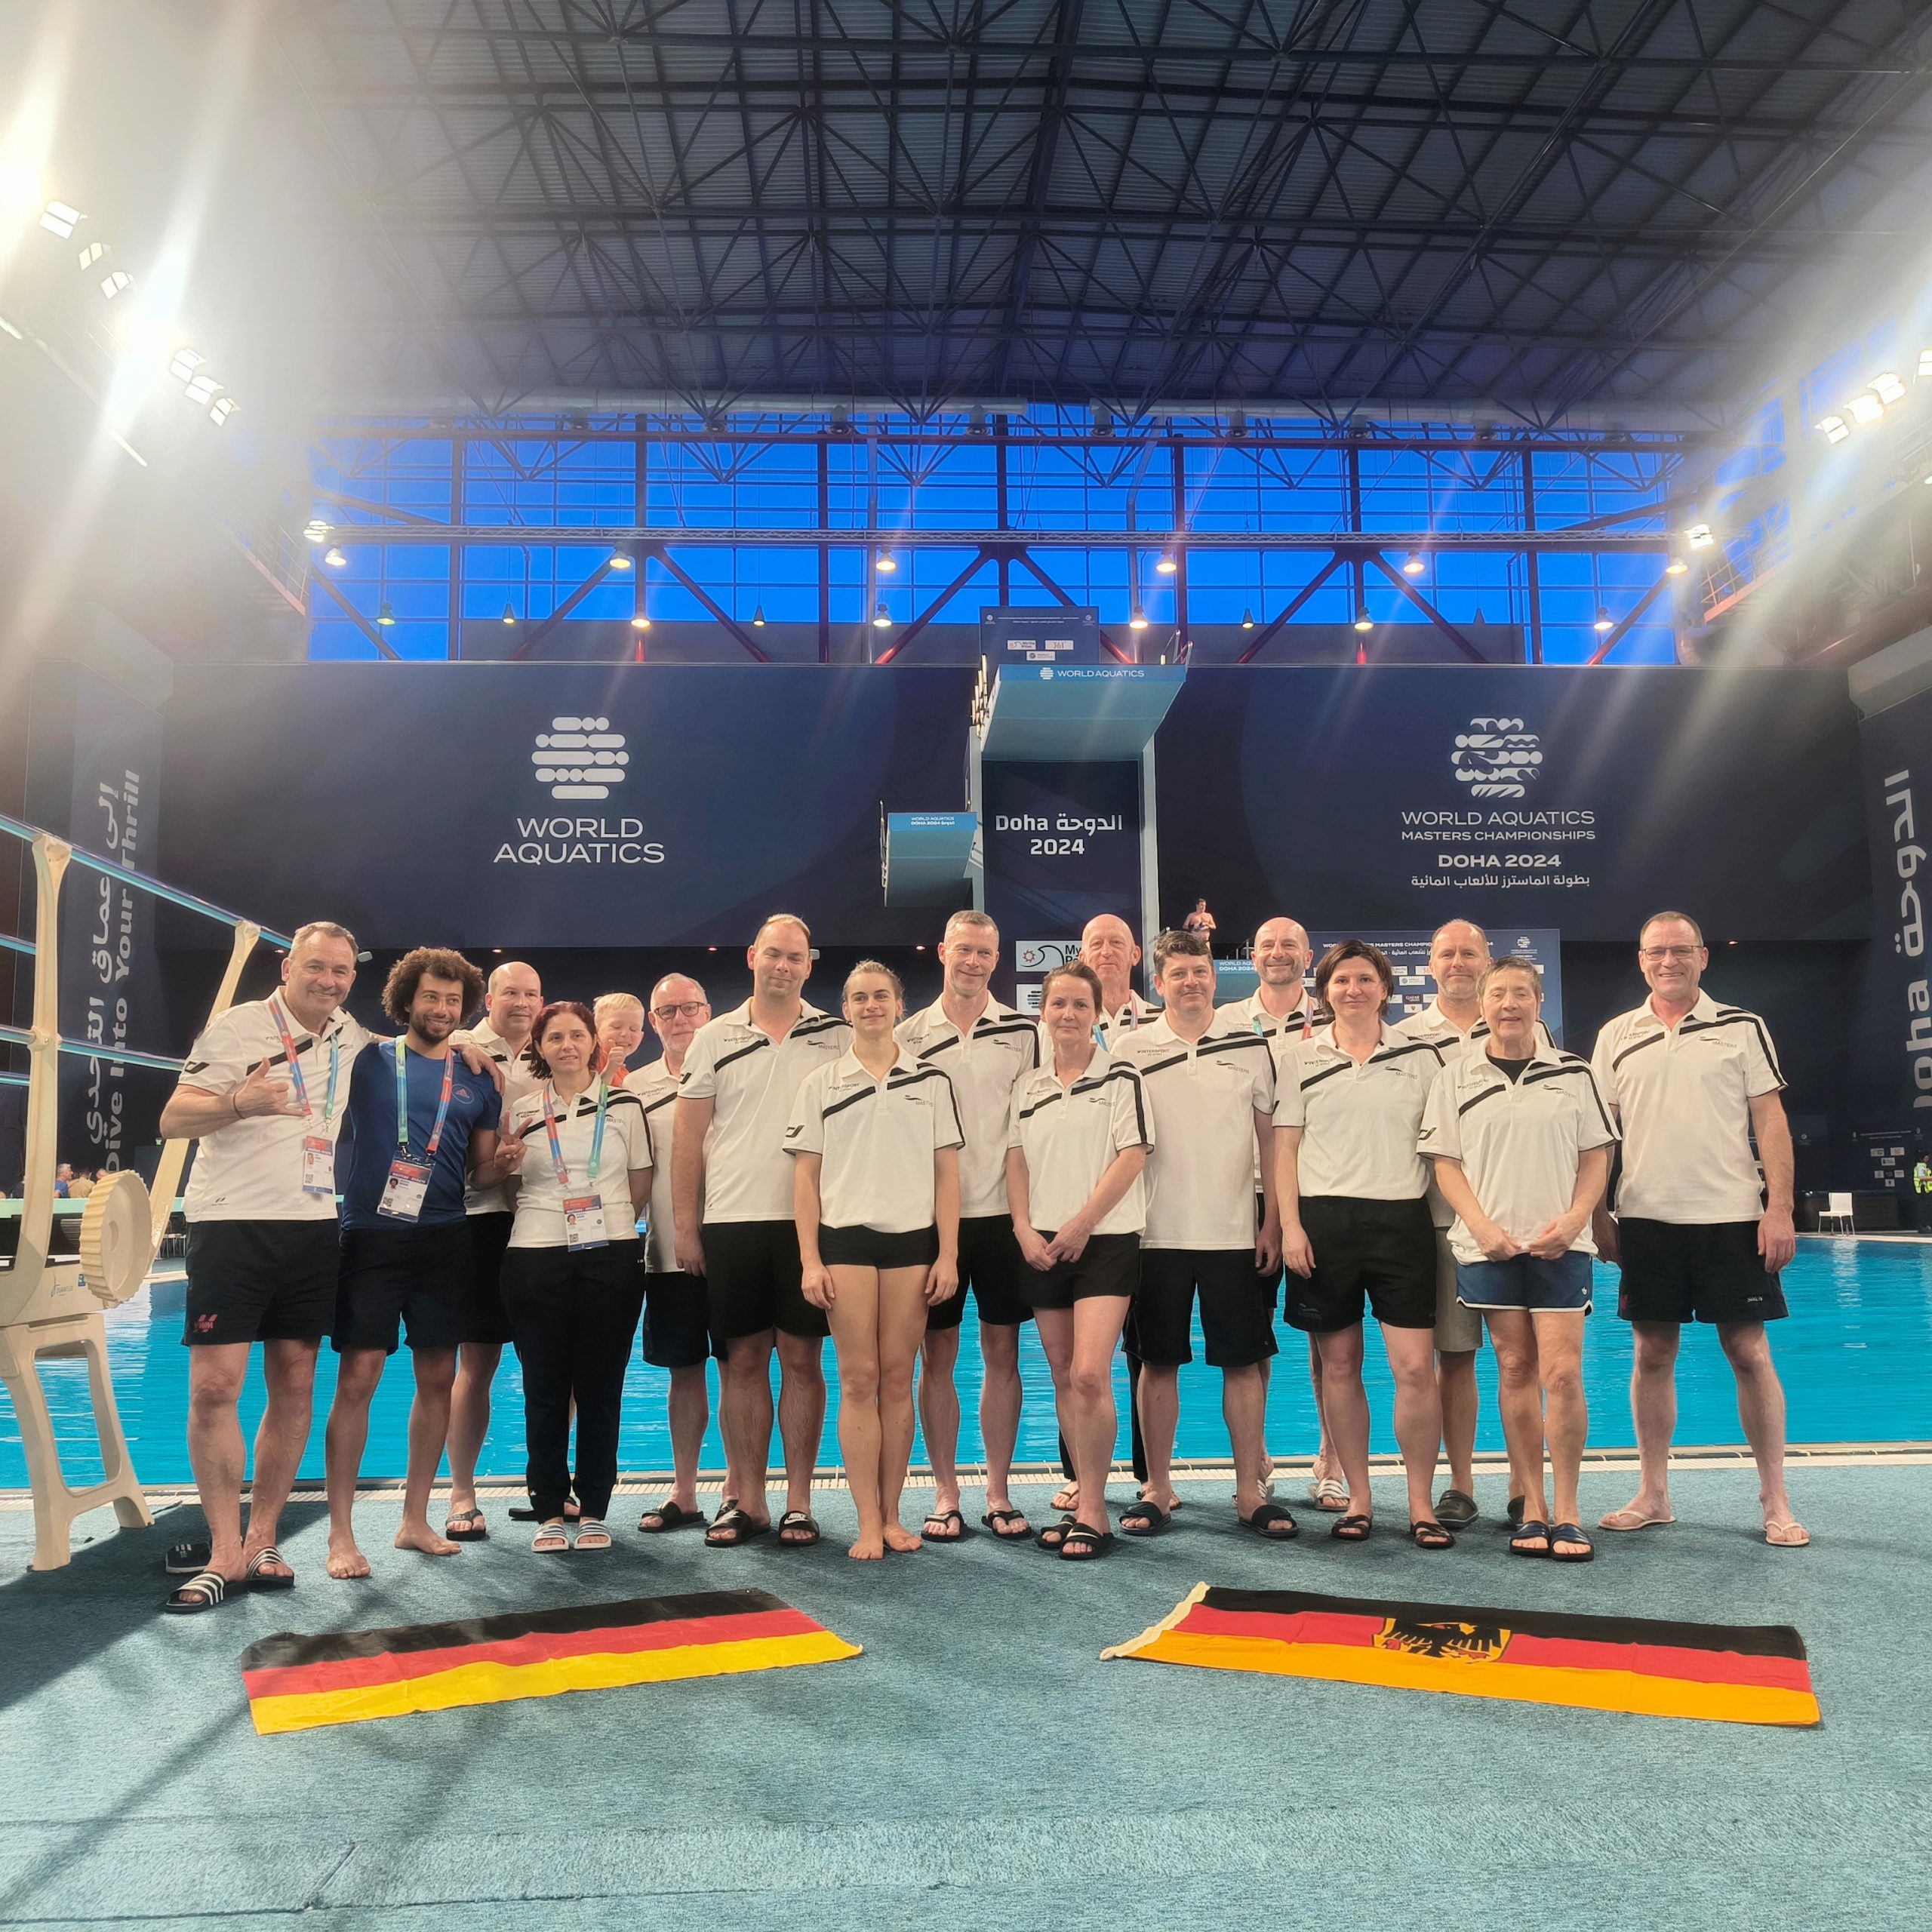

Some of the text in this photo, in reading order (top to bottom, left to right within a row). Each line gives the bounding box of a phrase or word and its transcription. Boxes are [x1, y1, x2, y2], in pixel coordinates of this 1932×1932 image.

[1057, 669, 1145, 678] WORLD AQUATICS
[122, 769, 140, 870] Thrill
[995, 812, 1122, 837] Doha الدوحة
[1401, 810, 1595, 827] WORLD AQUATICS
[516, 817, 644, 838] WORLD
[1401, 830, 1596, 841] MASTERS CHAMPIONSHIPS
[493, 842, 666, 866] AQUATICS
[1030, 838, 1085, 855] 2024
[1438, 854, 1562, 868] DOHA 2024
[1884, 769, 1927, 958] الدوحة
[1411, 874, 1590, 889] بطولة الماسترز للألعاب المائية
[115, 888, 133, 982] Your
[788, 1511, 808, 1520] NIKE
